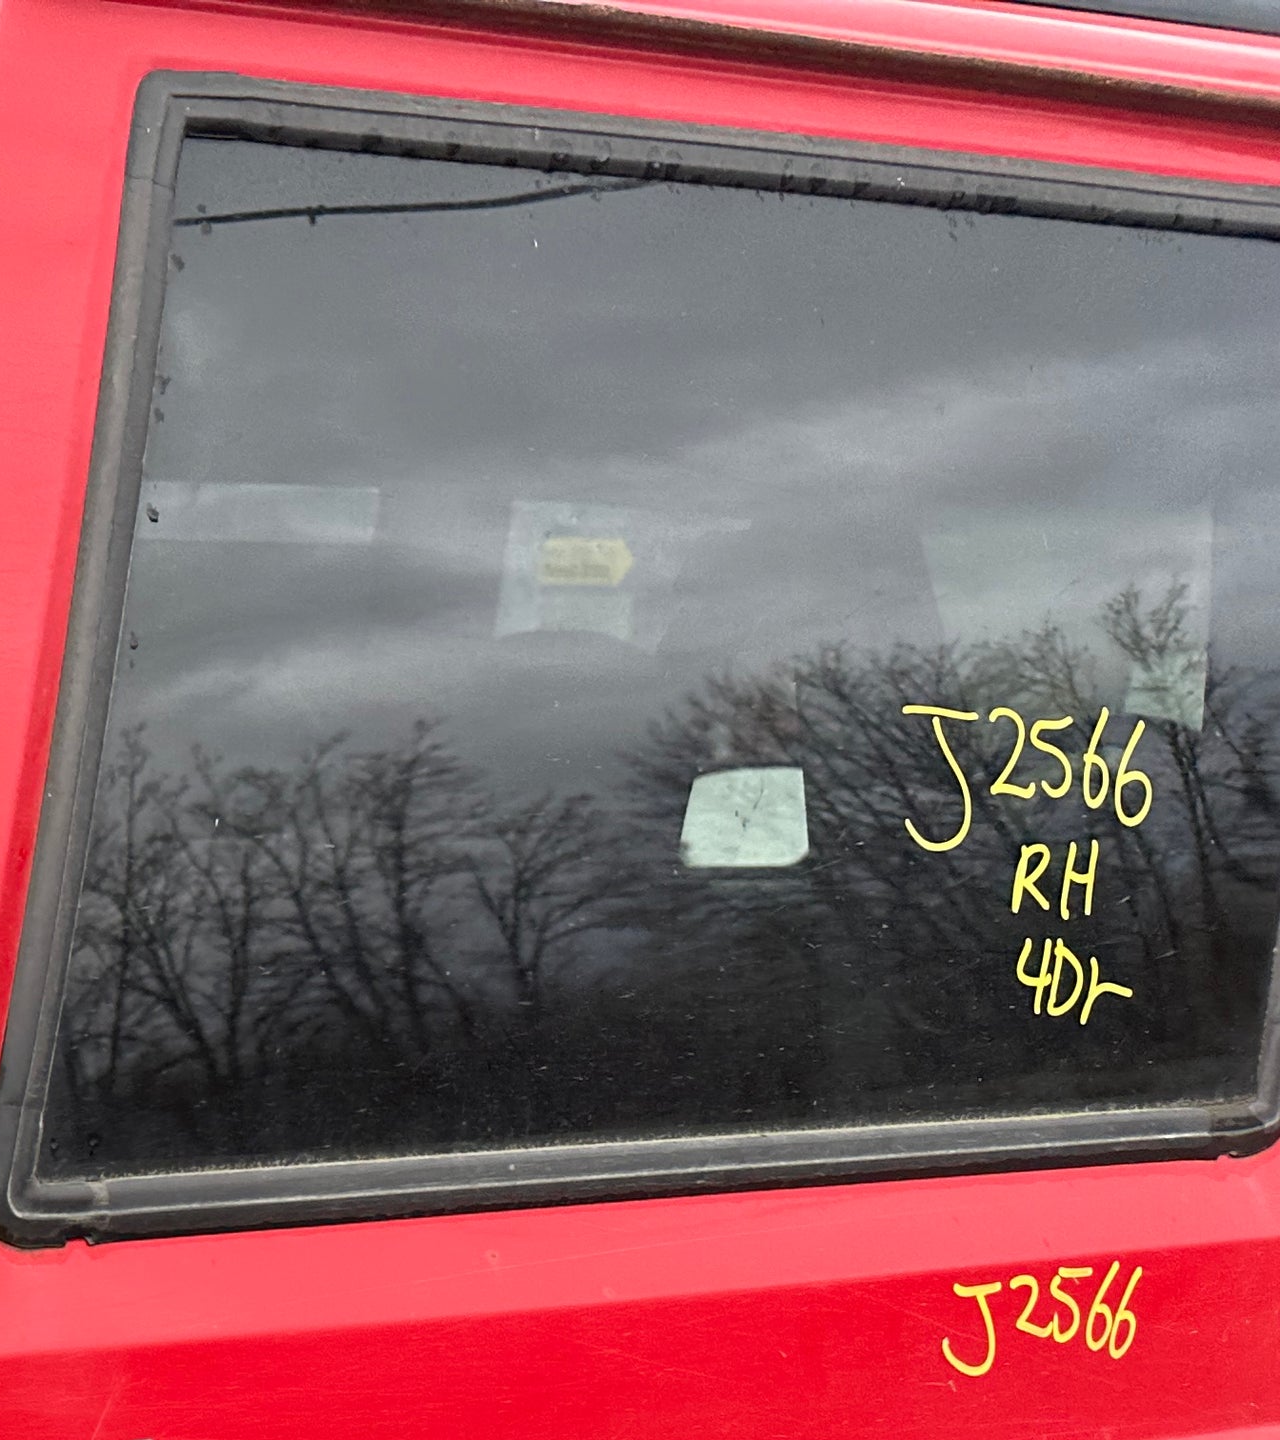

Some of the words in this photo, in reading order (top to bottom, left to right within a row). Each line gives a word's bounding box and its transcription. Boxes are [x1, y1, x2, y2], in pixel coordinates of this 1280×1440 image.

[902, 705, 1153, 852] J2566
[1011, 839, 1100, 921] RH
[1015, 937, 1134, 1026] 4Dr
[941, 1260, 1143, 1377] J2566
